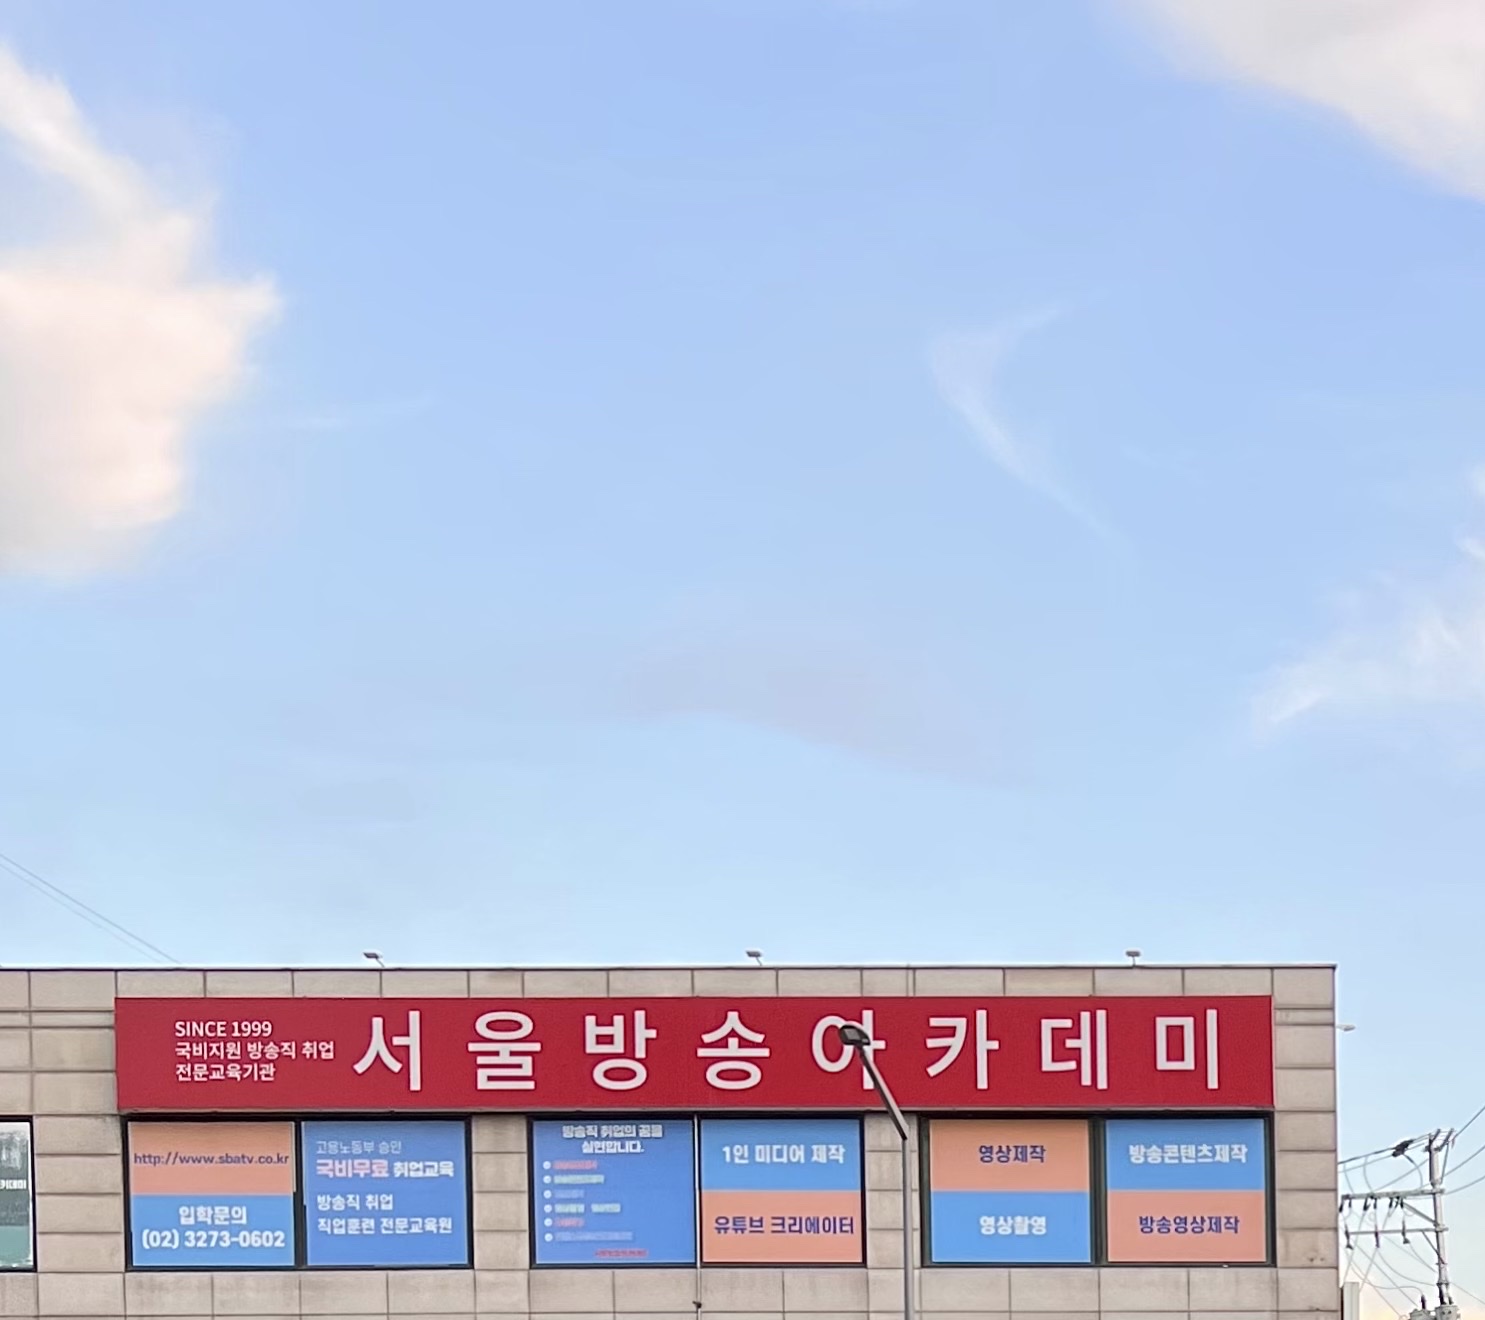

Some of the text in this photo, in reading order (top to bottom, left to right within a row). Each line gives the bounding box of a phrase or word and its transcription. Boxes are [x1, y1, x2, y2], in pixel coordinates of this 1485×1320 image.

[174, 1020, 273, 1038] SINCE 1999
[174, 1040, 335, 1061] 국비지원 방송직 취업
[352, 1008, 1220, 1092] 서울방송아카데미
[175, 1062, 276, 1082] 전문교육기관
[134, 1151, 290, 1167] http://www.sbatv.co.kr
[722, 1144, 847, 1164] 1인 미디어 제작
[978, 1144, 1047, 1164] 영상제작
[1128, 1144, 1248, 1164] 방송콘텐츠제작
[315, 1158, 455, 1179] 국비무료 취업교육
[316, 1193, 394, 1212] 방송직 취업
[178, 1205, 248, 1226] 입학문의
[317, 1216, 453, 1235] 직업훈련 전문교육원
[714, 1215, 855, 1235] 유튜브 크리에이터
[1138, 1215, 1241, 1235] 방송영상제작
[141, 1228, 286, 1250] (02) 3273-0602
